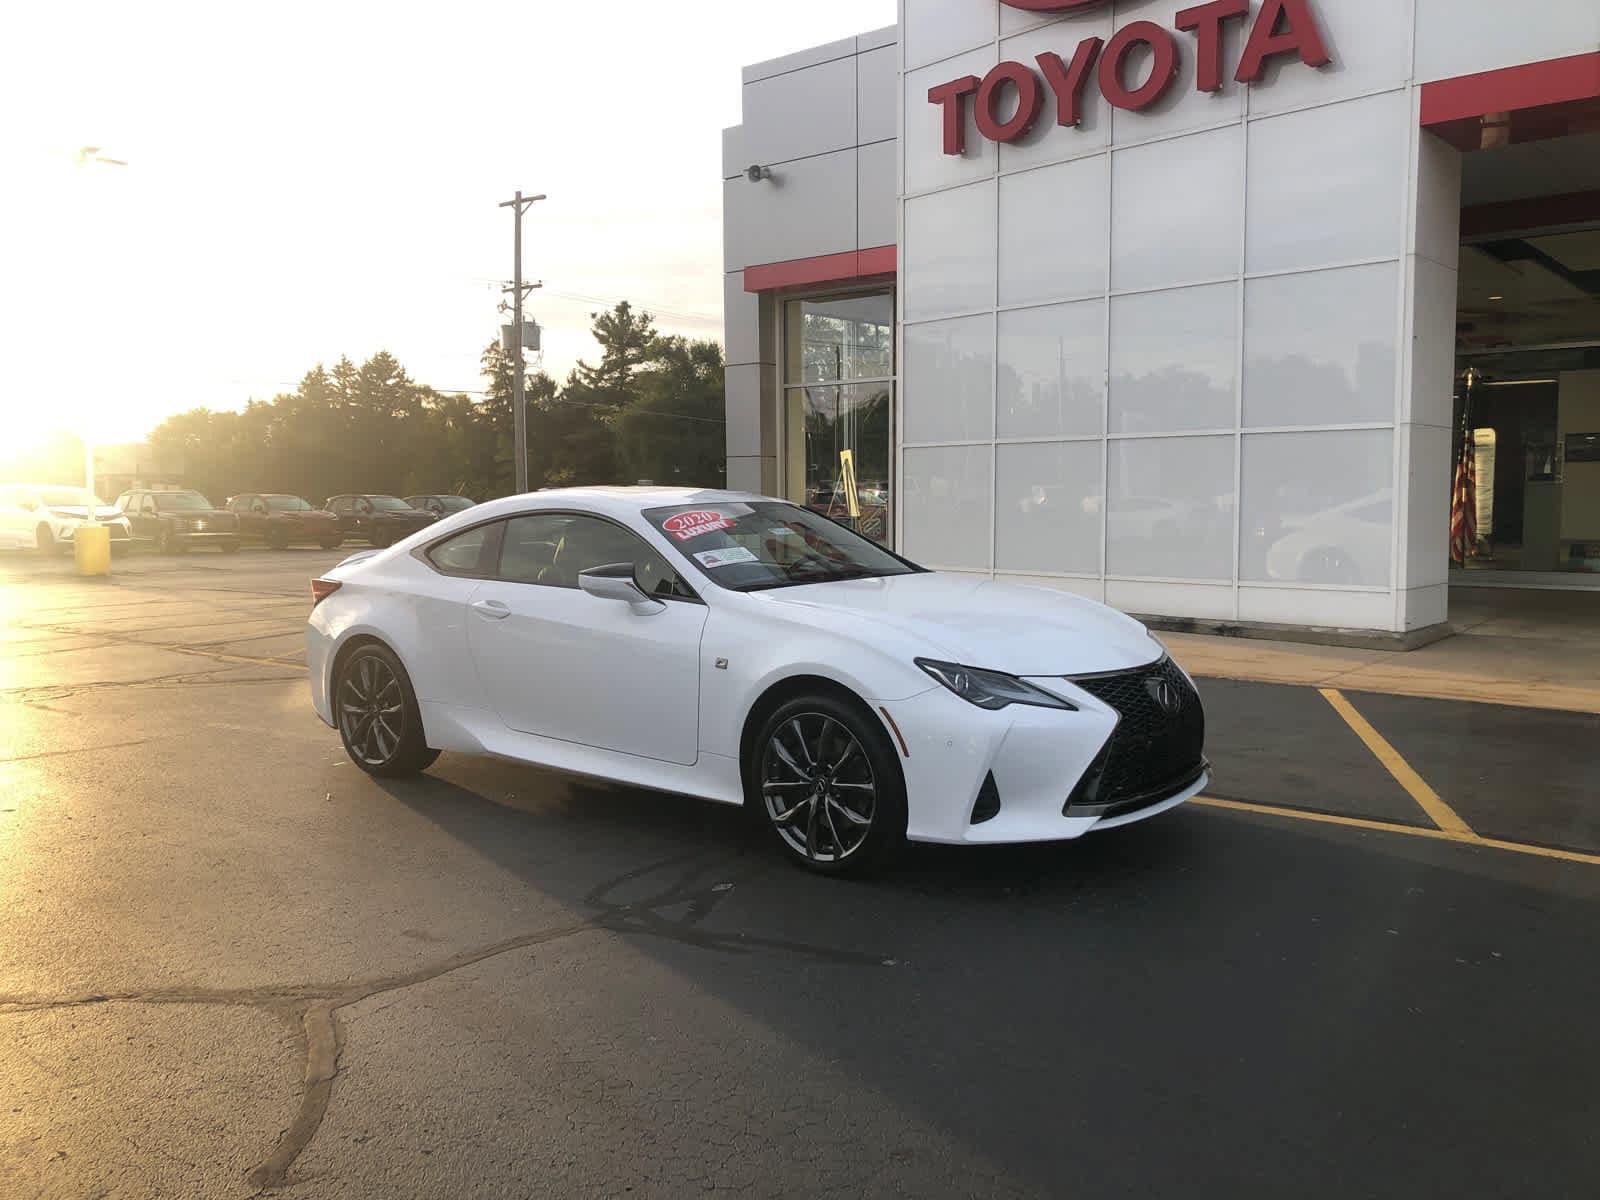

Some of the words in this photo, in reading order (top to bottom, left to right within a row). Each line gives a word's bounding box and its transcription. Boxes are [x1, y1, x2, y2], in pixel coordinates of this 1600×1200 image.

[928, 0, 1331, 155] TOYOTA
[674, 512, 713, 529] 2020
[677, 520, 729, 540] LUXURY
